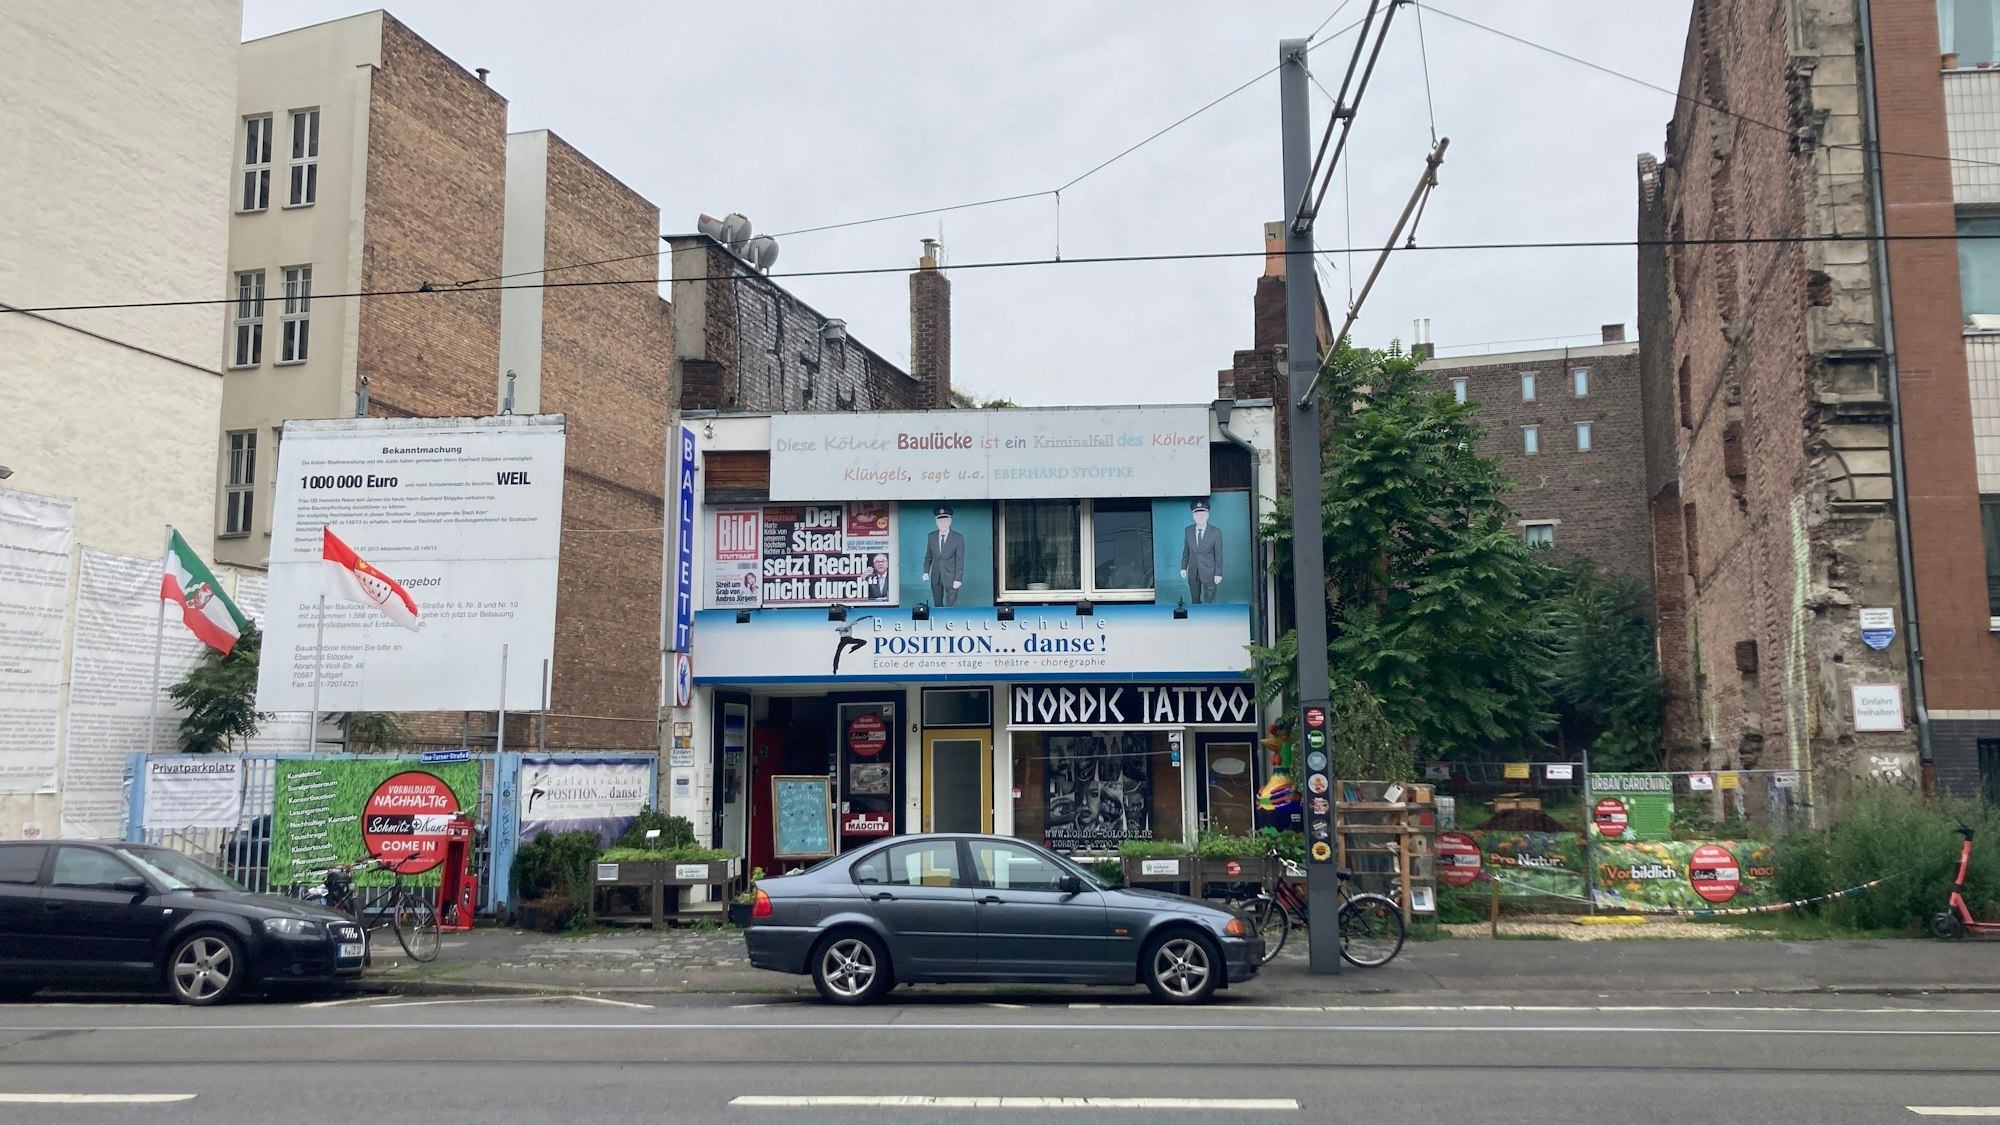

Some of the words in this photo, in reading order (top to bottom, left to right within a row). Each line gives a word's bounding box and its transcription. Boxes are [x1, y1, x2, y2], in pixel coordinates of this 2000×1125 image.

[776, 438, 816, 452] Diese
[824, 435, 890, 450] Kölner
[898, 432, 972, 450] Baulücke
[980, 436, 1000, 448] ist
[1006, 436, 1026, 448] ein
[1034, 434, 1114, 448] Kriminalfall
[1118, 432, 1144, 447] des
[1152, 432, 1204, 446] Kölner
[382, 446, 462, 455] Bekanntmachung
[367, 474, 398, 488] Euro
[497, 472, 531, 485] WEIL
[844, 466, 911, 484] Klüngels,
[920, 470, 950, 484] sagt
[958, 470, 984, 480] u.a.
[994, 467, 1069, 480] EBERHARD
[1072, 464, 1134, 479] STÖPPKE
[720, 514, 756, 550] Bild
[679, 438, 693, 648] BALLETT
[792, 530, 841, 551] Staat
[764, 554, 810, 576] setzt
[814, 553, 868, 575] Recht
[764, 578, 811, 600] nicht
[873, 616, 1106, 632] Ballettschule
[873, 634, 1016, 655] POSITION...
[873, 659, 899, 668] Ecole
[903, 659, 915, 668] de
[918, 659, 946, 667] danse
[958, 659, 983, 668] stage
[994, 658, 1029, 667] théâtre
[1041, 657, 1106, 668] chorégraphie
[1015, 686, 1124, 724] NORDIC
[1138, 686, 1248, 724] TATTOO
[912, 724, 918, 732] 8
[152, 762, 235, 773] Privatparkplatz
[389, 785, 436, 794] VORBILDLICH
[1592, 777, 1620, 790] URBAN
[1623, 777, 1671, 791] GARDENING
[288, 793, 336, 804] Konzertlocation
[375, 795, 448, 808] NACHHALTIG
[290, 806, 329, 816] Lesungsraum
[290, 819, 326, 828] Nachhaltige
[369, 816, 410, 833] Schmitz
[291, 830, 327, 840] Tauschregal
[1045, 830, 1152, 838] WWW.NORDIC-COLOGNE.DE
[292, 842, 332, 853] Kleidertausch
[382, 840, 419, 851] COME
[423, 840, 435, 851] IN
[292, 854, 338, 865] Pflanzentausch
[1490, 854, 1516, 864] Pro
[1518, 853, 1564, 867] Natur.
[1607, 865, 1675, 880] Vorbildlich
